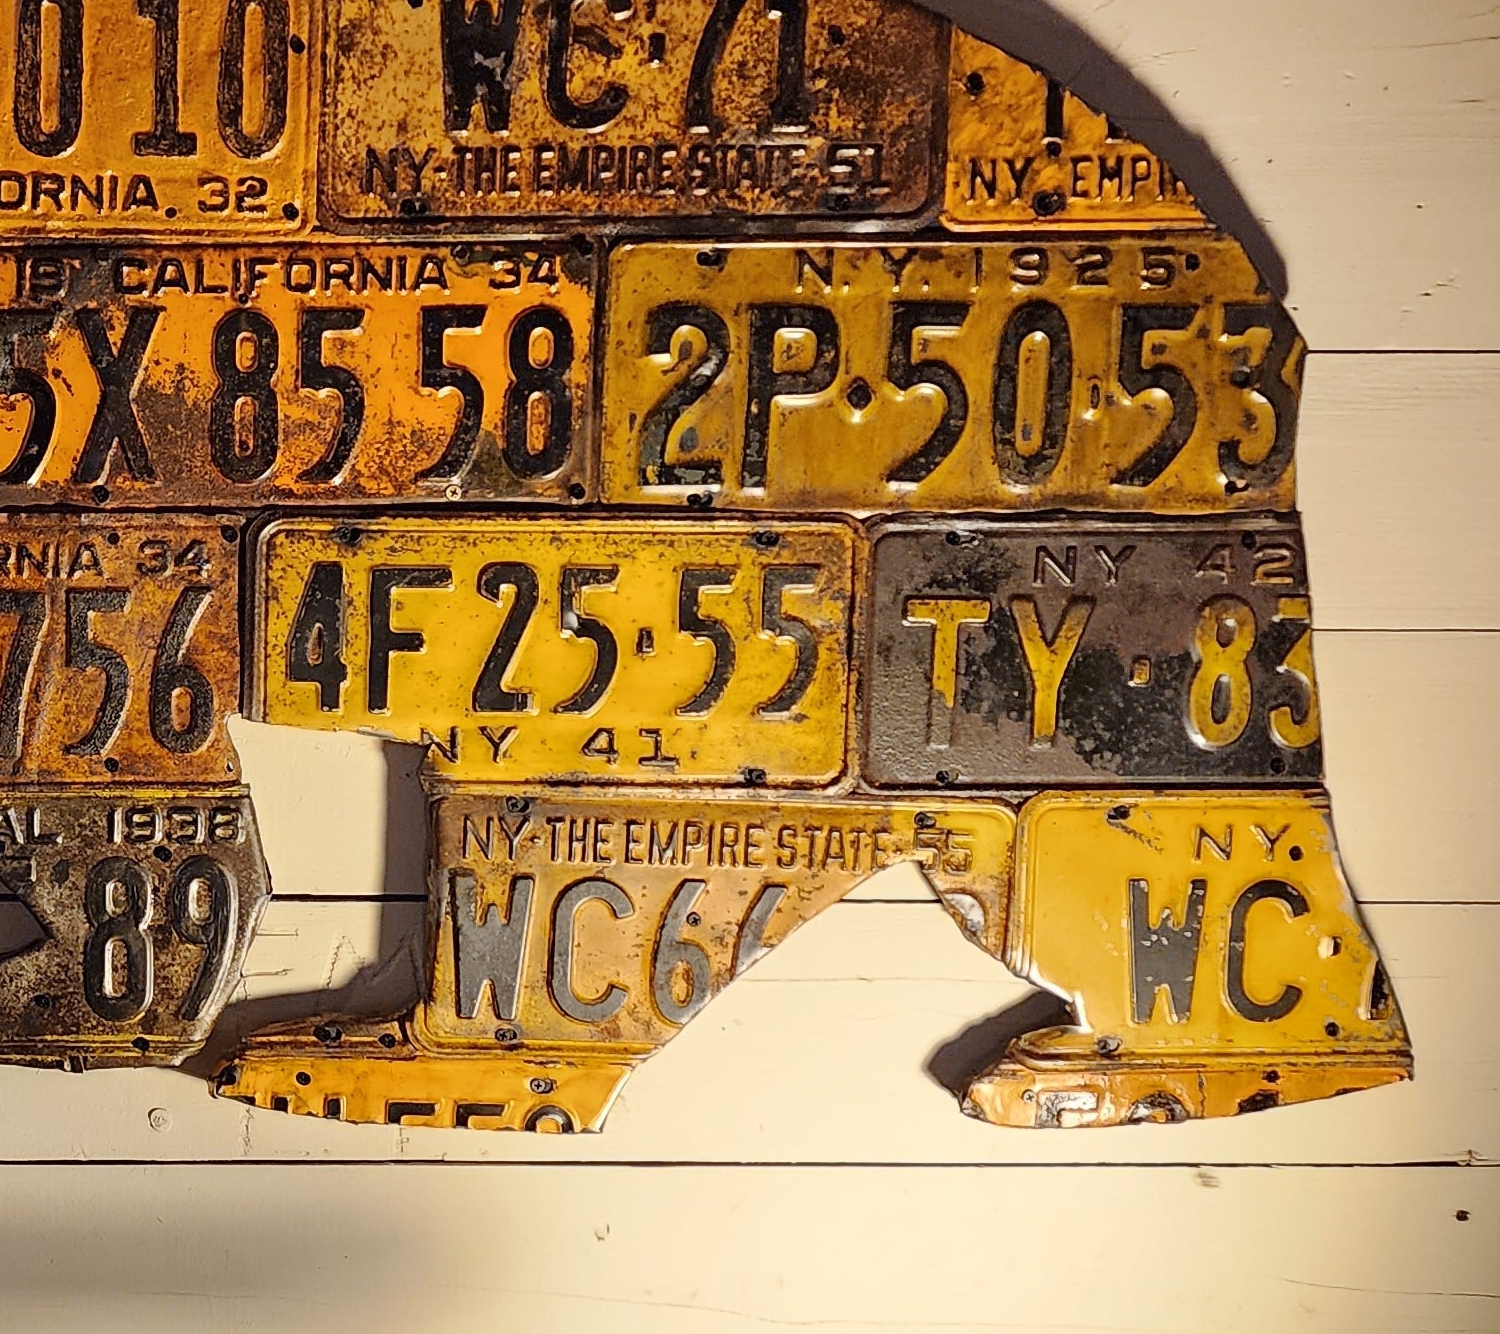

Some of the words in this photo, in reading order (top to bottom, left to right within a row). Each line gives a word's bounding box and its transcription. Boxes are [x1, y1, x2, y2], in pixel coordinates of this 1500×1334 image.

[196, 176, 269, 213] 32
[532, 147, 677, 197] EMPIRE
[966, 157, 1036, 205] NY
[15, 256, 68, 299] 19
[113, 256, 450, 297] CALIFORNIA
[487, 254, 562, 294] 34
[973, 245, 1176, 293] 1925
[208, 305, 368, 486] 85
[414, 305, 577, 486] 58
[137, 539, 213, 579] 34
[1033, 543, 1138, 587] NY
[1196, 542, 1295, 587] 42
[418, 726, 515, 766] NY
[580, 725, 680, 767] 41
[107, 806, 246, 845] 1938
[623, 820, 764, 869] EMPIRE
[1192, 822, 1294, 863] NY
